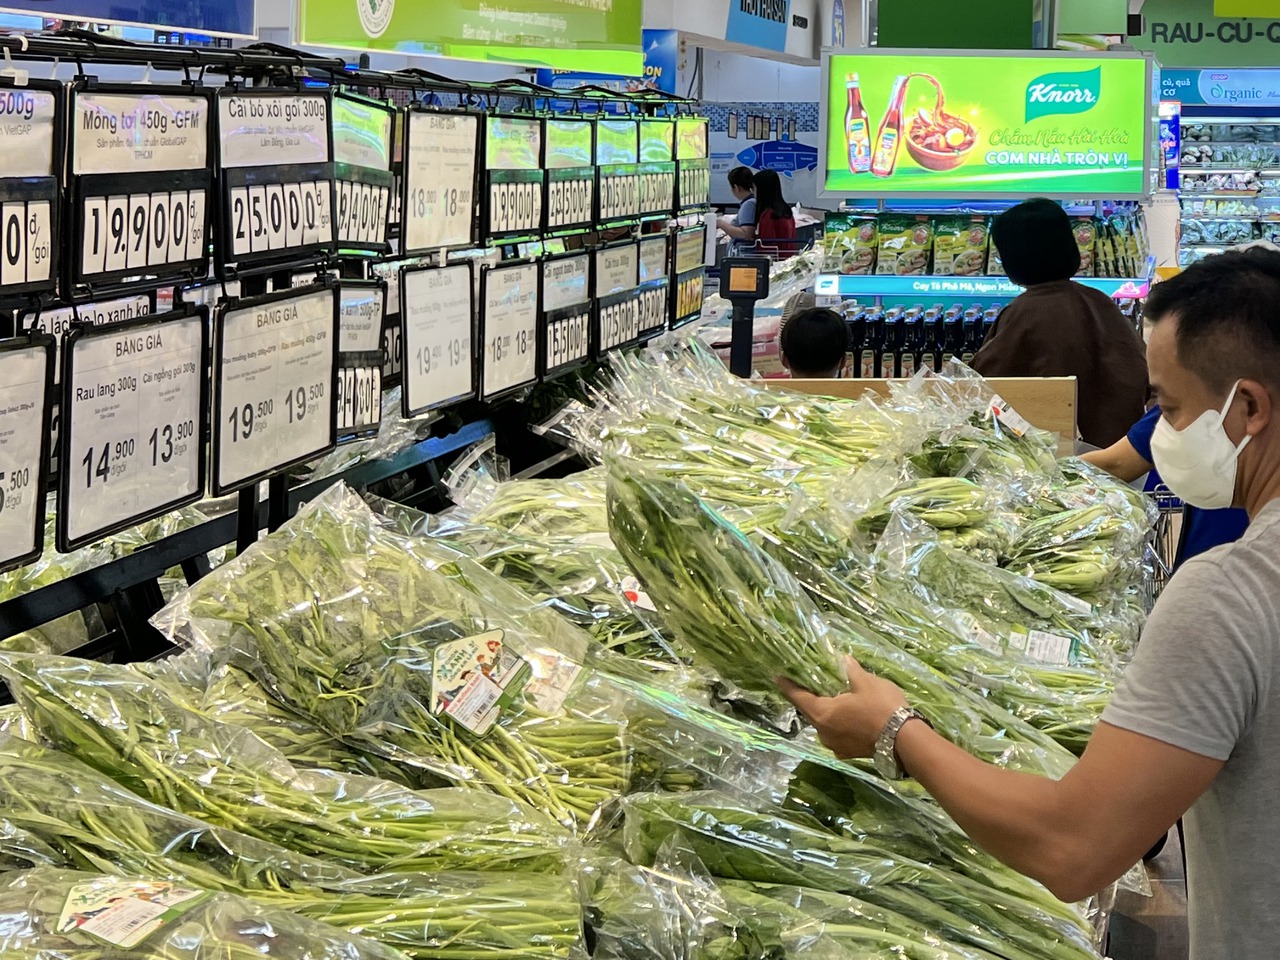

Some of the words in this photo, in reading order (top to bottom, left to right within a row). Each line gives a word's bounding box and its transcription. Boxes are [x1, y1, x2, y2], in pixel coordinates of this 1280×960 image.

[1028, 83, 1096, 103] Knorr
[1210, 84, 1262, 102] Organic
[83, 106, 117, 134] Mồng
[141, 111, 168, 133] 450g
[250, 100, 264, 118] bó
[267, 100, 282, 118] xôi
[303, 100, 325, 121] 300g
[986, 151, 1024, 165] CƠM
[1029, 148, 1062, 165] NHÀ
[1064, 148, 1109, 165] TRÒN
[1113, 152, 1128, 168] VỊ
[234, 190, 315, 239] 25.000
[92, 201, 185, 255] 19.900
[257, 310, 281, 328] BẢNG
[284, 304, 298, 322] GIÁ
[116, 337, 144, 357] BẢNG
[146, 334, 162, 354] GIÁ
[77, 387, 94, 401] Rau
[97, 383, 115, 397] lang
[118, 376, 136, 391] 300g
[285, 382, 324, 424] 19.500
[229, 399, 274, 443] 19.500
[150, 420, 194, 467] 13.900
[82, 438, 135, 489] 14.900
